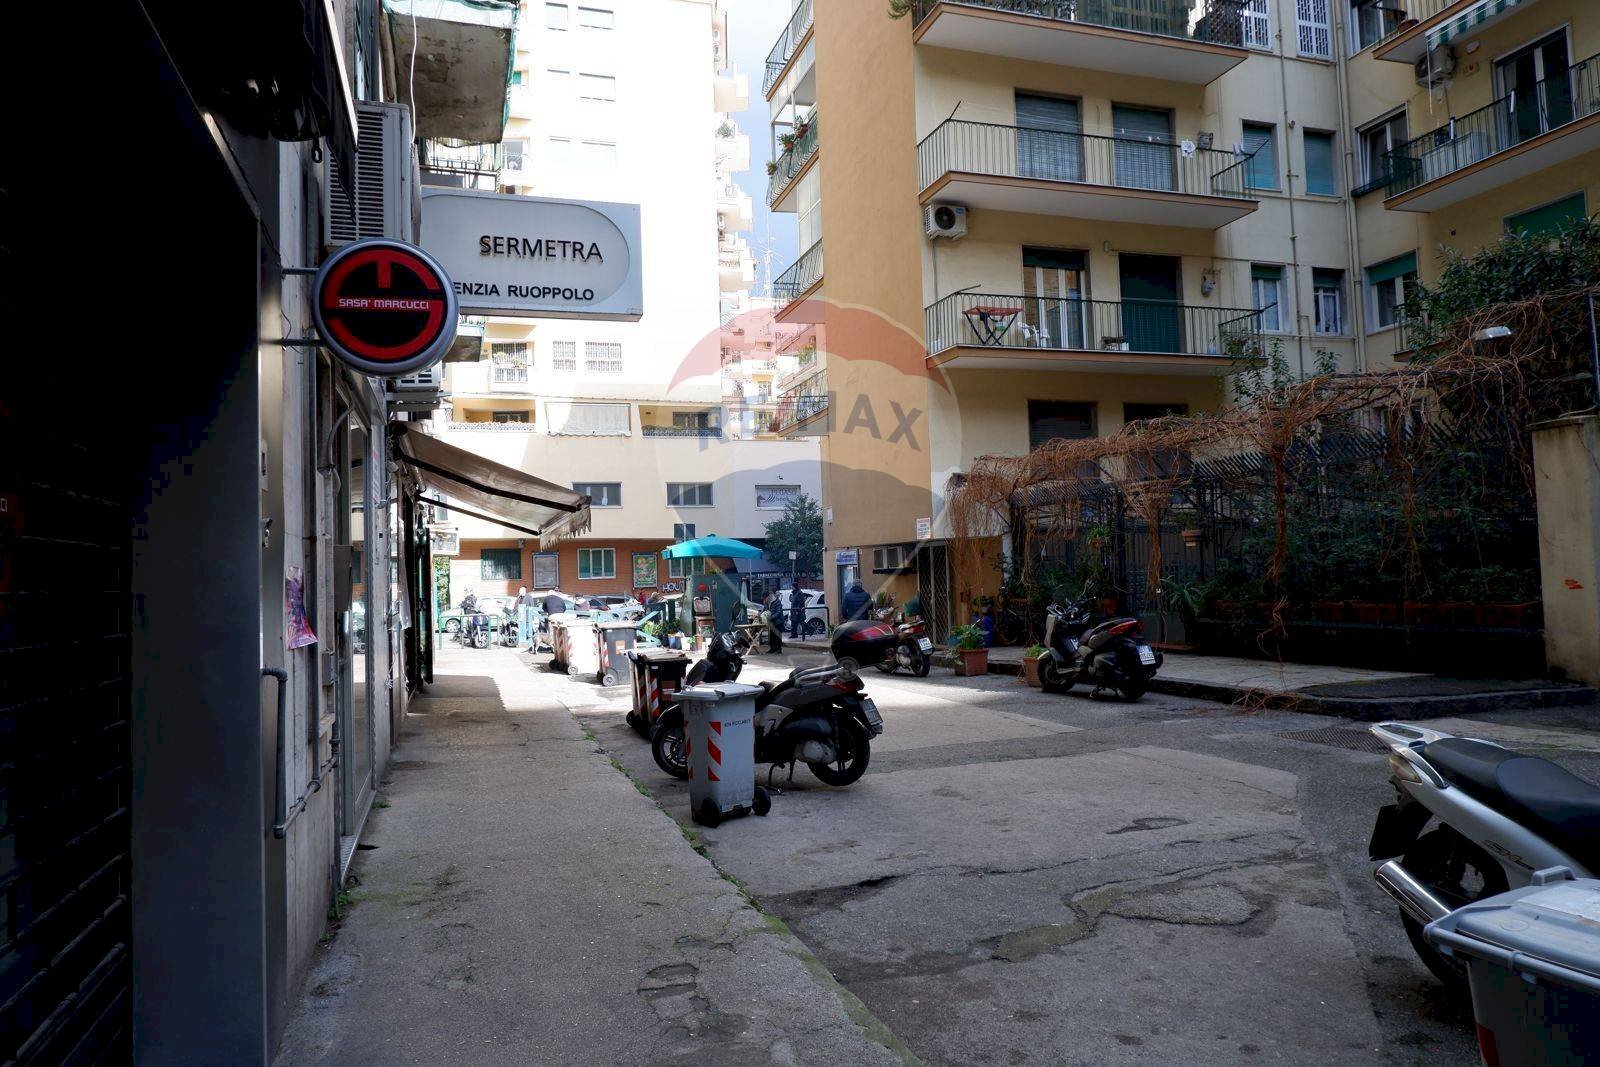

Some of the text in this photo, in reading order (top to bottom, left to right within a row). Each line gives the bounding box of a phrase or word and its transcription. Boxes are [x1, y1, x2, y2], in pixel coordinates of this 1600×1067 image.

[479, 235, 604, 263] SERMETRA
[508, 285, 594, 301] RUOPPOLO
[374, 299, 429, 309] MARCUCCI
